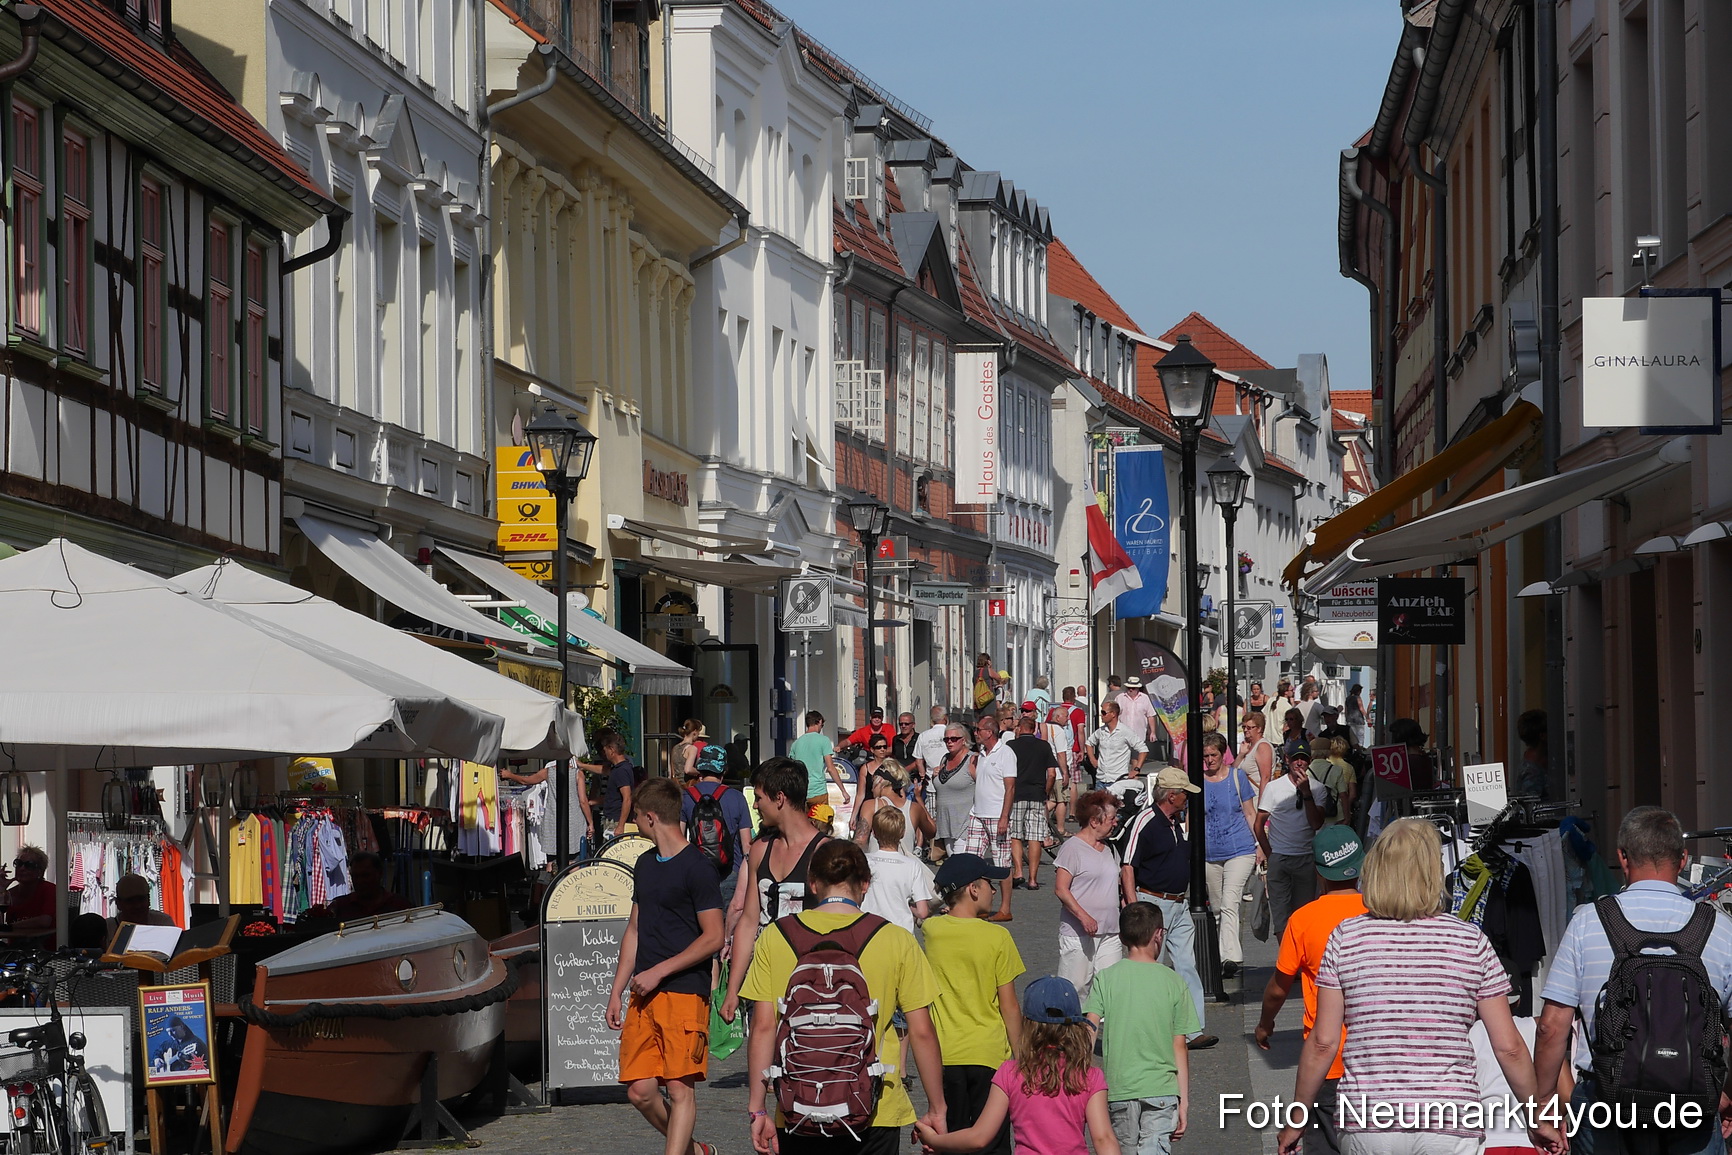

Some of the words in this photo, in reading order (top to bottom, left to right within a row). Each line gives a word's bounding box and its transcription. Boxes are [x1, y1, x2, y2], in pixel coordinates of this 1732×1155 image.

[1594, 355, 1701, 367] GINALAURA
[977, 361, 994, 420] Gastes
[983, 426, 994, 445] des
[977, 451, 994, 495] Haus
[511, 481, 538, 490] BHW
[1008, 513, 1047, 547] FRISEUR
[509, 533, 550, 543] DHL
[915, 589, 964, 600] Löwen-Apotheke
[1331, 585, 1375, 597] WÄSCHE
[1387, 595, 1445, 607] Anzieh
[1331, 609, 1375, 618] Nähzubehör
[1427, 607, 1456, 617] BAR
[511, 614, 554, 633] AOK
[794, 615, 818, 625] ZONE
[1235, 641, 1260, 650] ZONE
[1378, 752, 1403, 776] 30
[1466, 770, 1502, 785] NEUE
[1468, 784, 1503, 792] KOLLEKTION
[550, 868, 599, 910] RESTAURANT
[577, 903, 618, 916] U-NAUTIC
[582, 927, 619, 947] Kalte
[553, 949, 620, 977] Gurken-Papri
[579, 970, 616, 986] suppe
[147, 1006, 165, 1014] RALF
